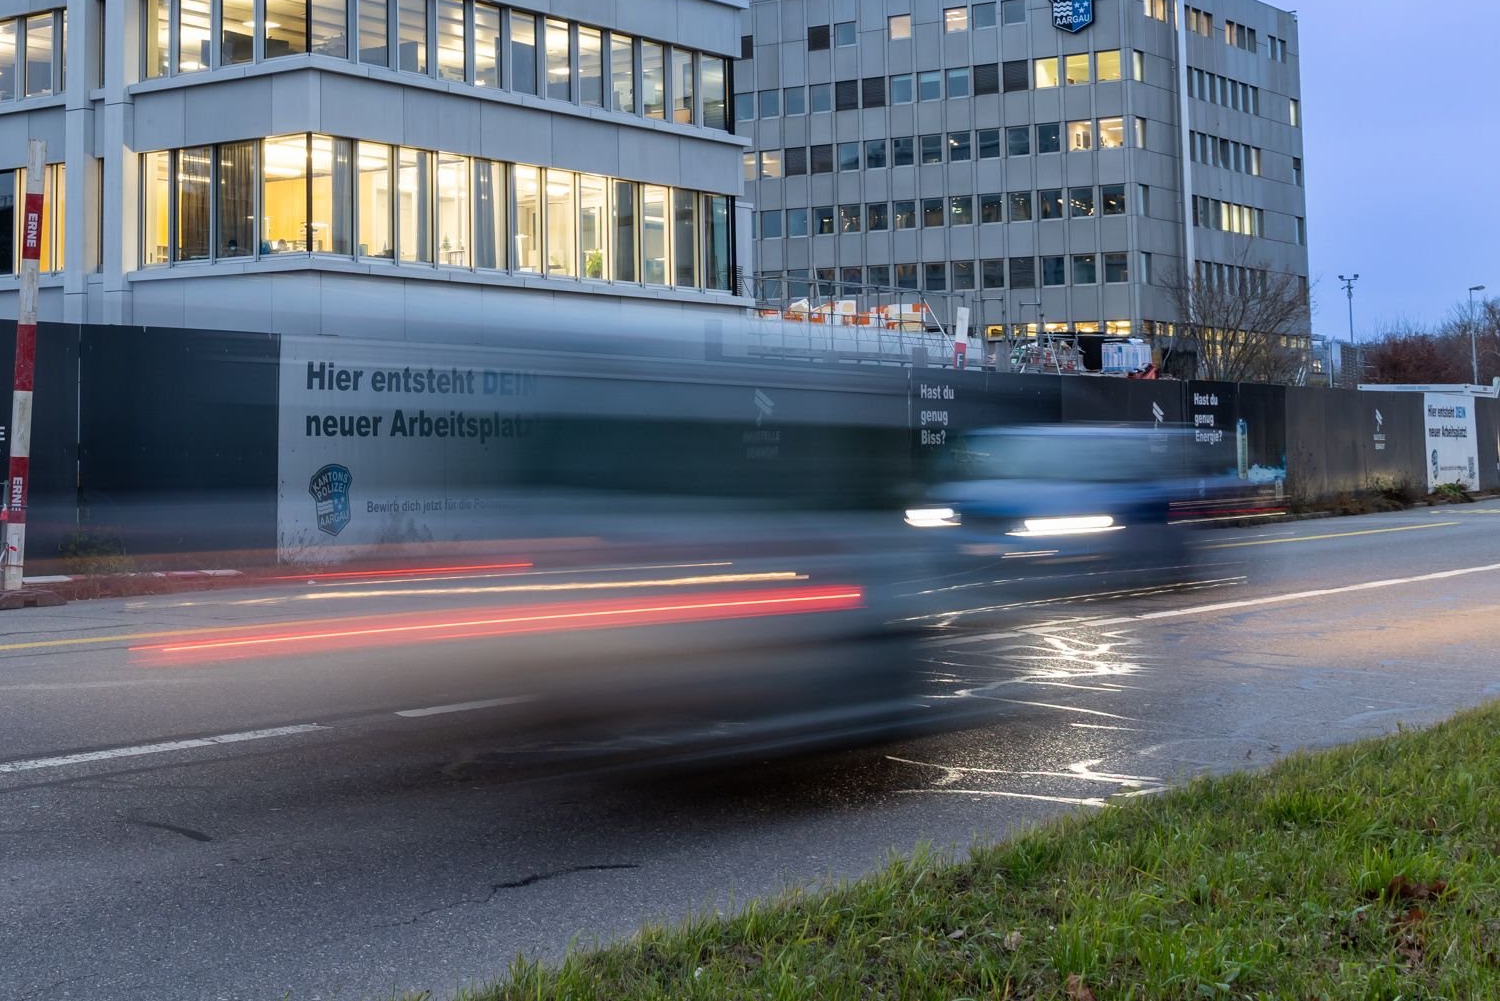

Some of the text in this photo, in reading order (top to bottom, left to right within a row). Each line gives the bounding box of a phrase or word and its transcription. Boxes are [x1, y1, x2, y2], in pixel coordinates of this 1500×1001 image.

[1056, 14, 1090, 25] AARGAU
[26, 213, 38, 248] ERNE
[307, 361, 363, 391] Hier
[371, 367, 475, 394] entsteht
[920, 384, 955, 400] Hast du
[1193, 393, 1219, 406] Hast du
[306, 414, 383, 437] neuer
[920, 409, 948, 426] genug
[1194, 414, 1214, 427] genug
[921, 429, 946, 445] Biss?
[1195, 430, 1222, 445] Energie?
[312, 471, 349, 493] KANTONS
[317, 483, 347, 500] POLIZEI
[367, 499, 399, 513] Bewirb
[402, 500, 421, 512] dich
[422, 500, 443, 514] jetzt
[444, 499, 457, 511] für
[319, 511, 350, 527] AARGAU
